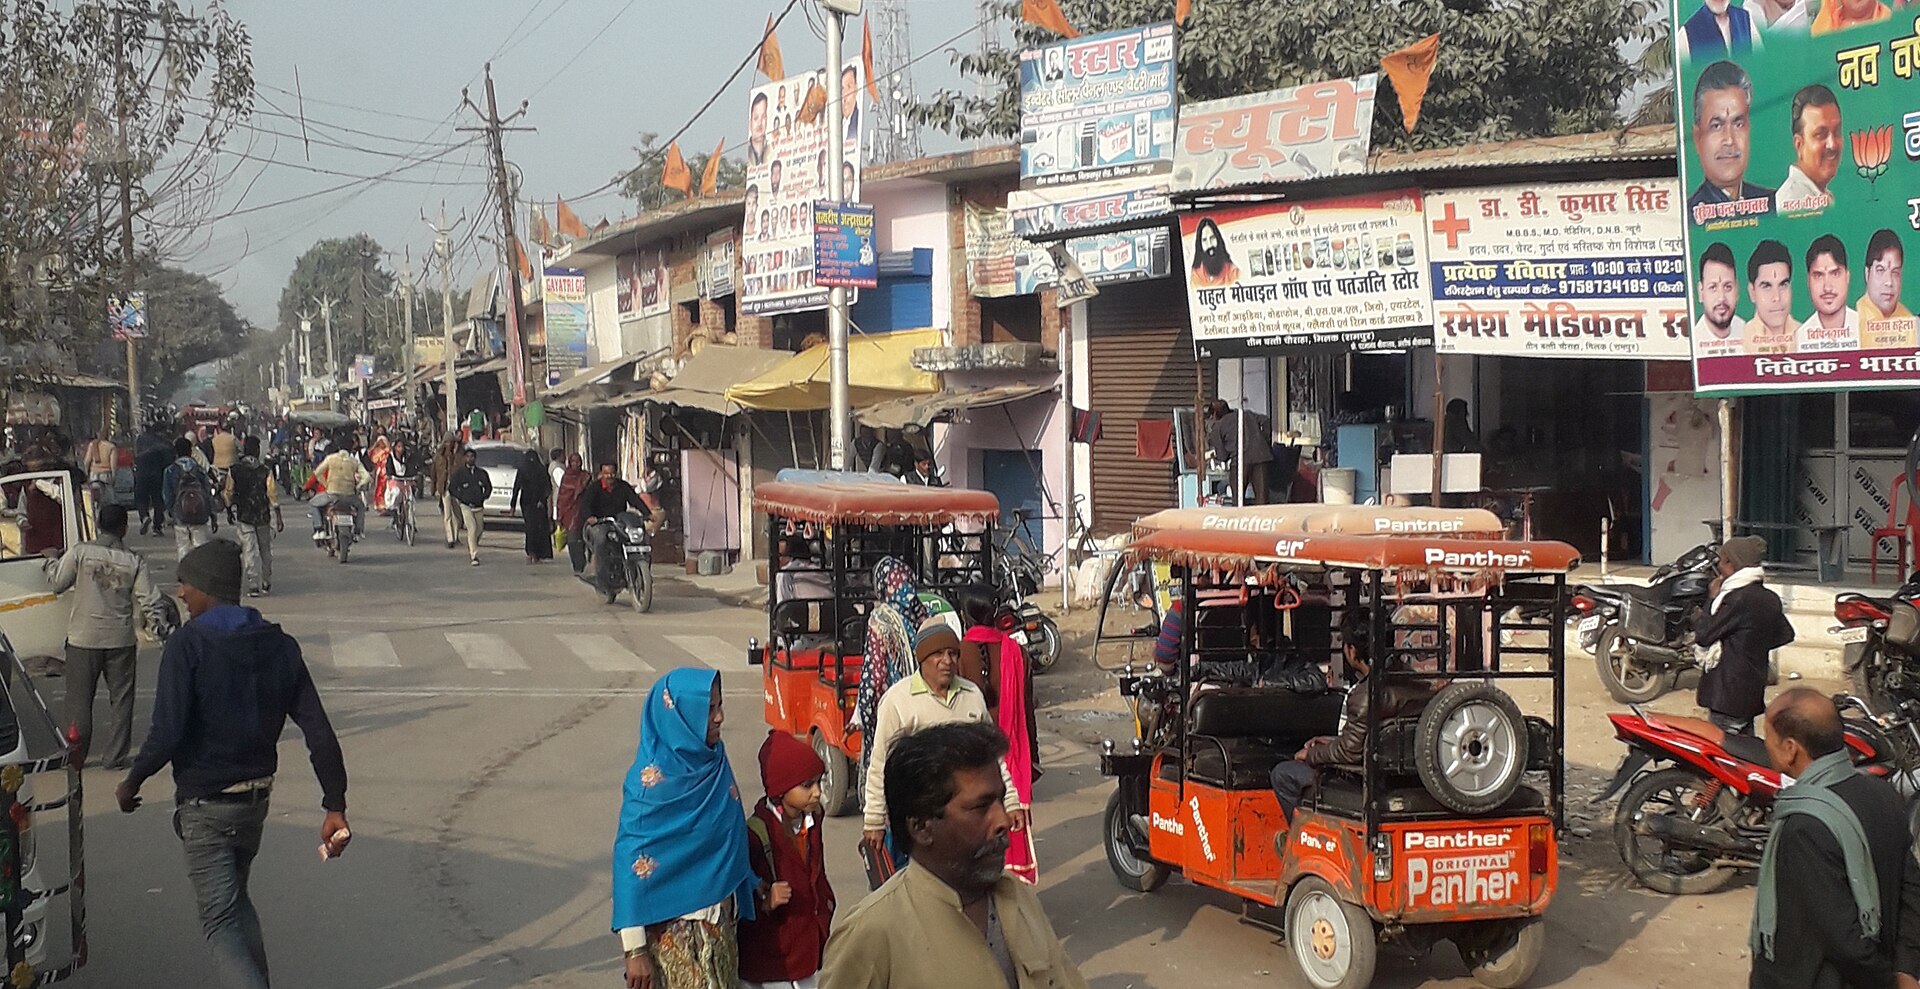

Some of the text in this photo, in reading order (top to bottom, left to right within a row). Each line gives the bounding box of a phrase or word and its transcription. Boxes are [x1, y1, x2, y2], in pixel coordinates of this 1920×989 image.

[1066, 34, 1141, 78] स्टार
[1836, 43, 1881, 88] नव
[1179, 79, 1375, 168] ब्यूटी
[1062, 194, 1127, 225] स्टार
[1479, 184, 1670, 221] डा. डी. कुमार सिंह
[1492, 244, 1513, 255] उदर,
[1607, 239, 1621, 251] रोग
[1442, 260, 1498, 282] प्रत्येक
[1503, 260, 1568, 281] रविवार
[1591, 260, 1625, 276] 10:00
[1643, 258, 1653, 274] से
[546, 277, 575, 293] GAYATRI
[1196, 286, 1227, 312] राहुल
[1282, 276, 1308, 300] शॉप
[1312, 273, 1332, 297] एवं
[1337, 269, 1386, 296] पतंजलि
[1392, 268, 1420, 290] स्टोर
[1486, 283, 1501, 298] हेतु
[1558, 279, 1649, 294] 9758734189
[1416, 310, 1424, 323] है
[1439, 301, 1510, 338] रमेश
[1519, 301, 1648, 339] मेडिकल
[1425, 548, 1530, 567] Panther
[1404, 829, 1511, 850] Panther
[1435, 857, 1508, 870] ORIGINAL
